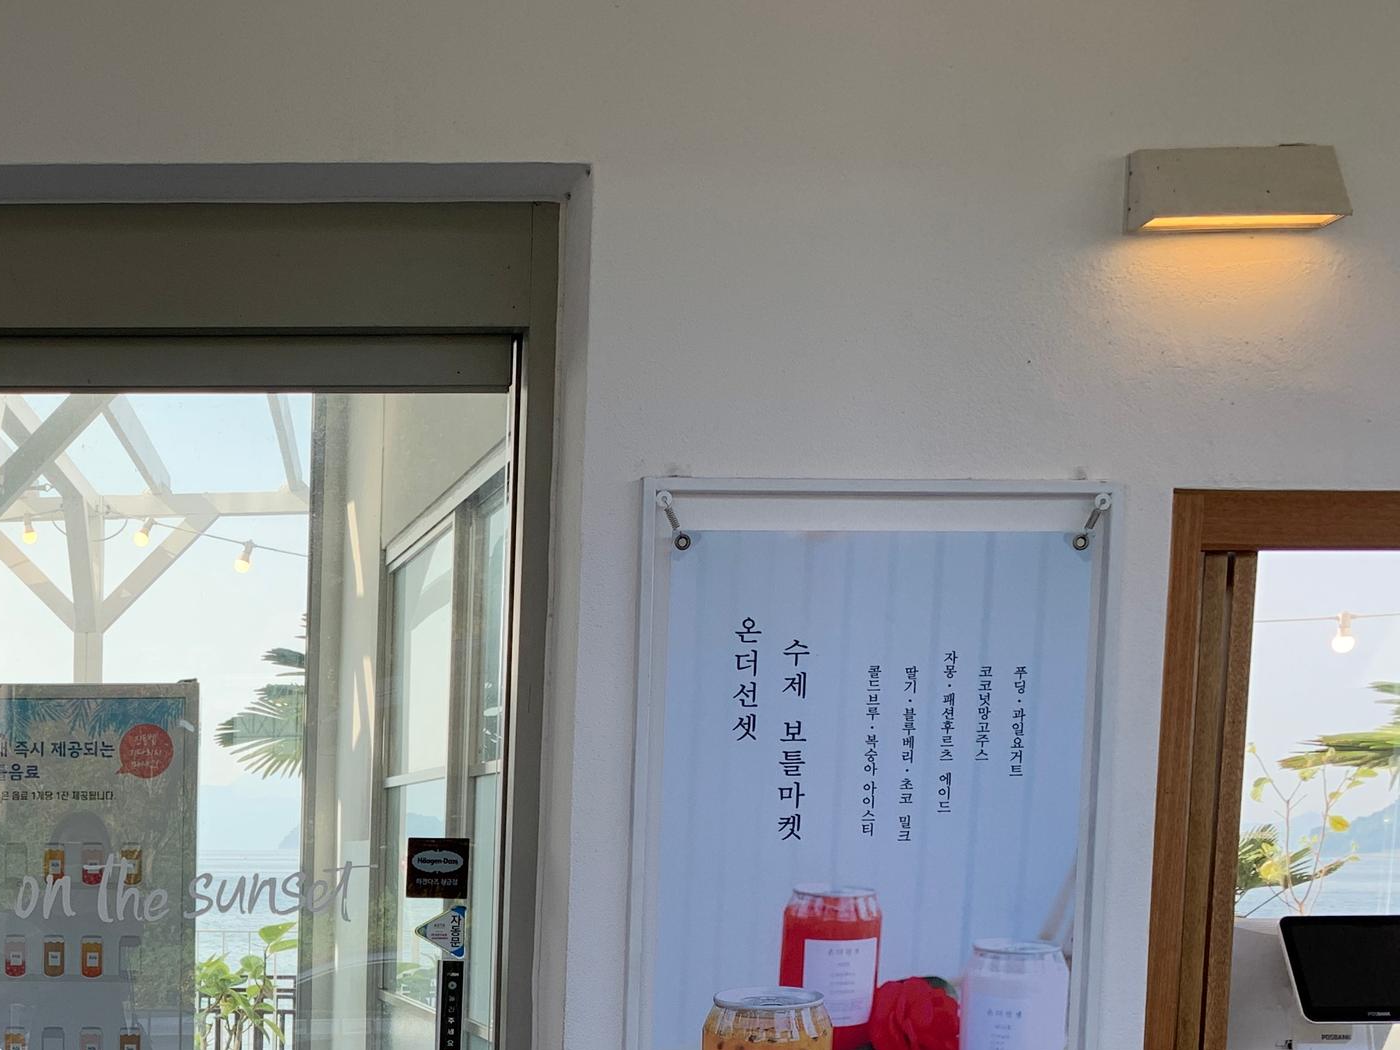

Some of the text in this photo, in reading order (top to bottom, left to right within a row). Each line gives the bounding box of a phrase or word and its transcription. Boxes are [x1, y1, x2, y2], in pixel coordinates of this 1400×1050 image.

[732, 616, 762, 742] 온더선셋
[14, 741, 44, 758] 즉시
[51, 741, 116, 759] 제공되는
[777, 639, 810, 842] 수제 보틀마켓
[937, 772, 953, 813] 에이드
[897, 814, 912, 842] 밀크
[15, 852, 379, 923] on the sunset
[449, 915, 462, 947] 자동문
